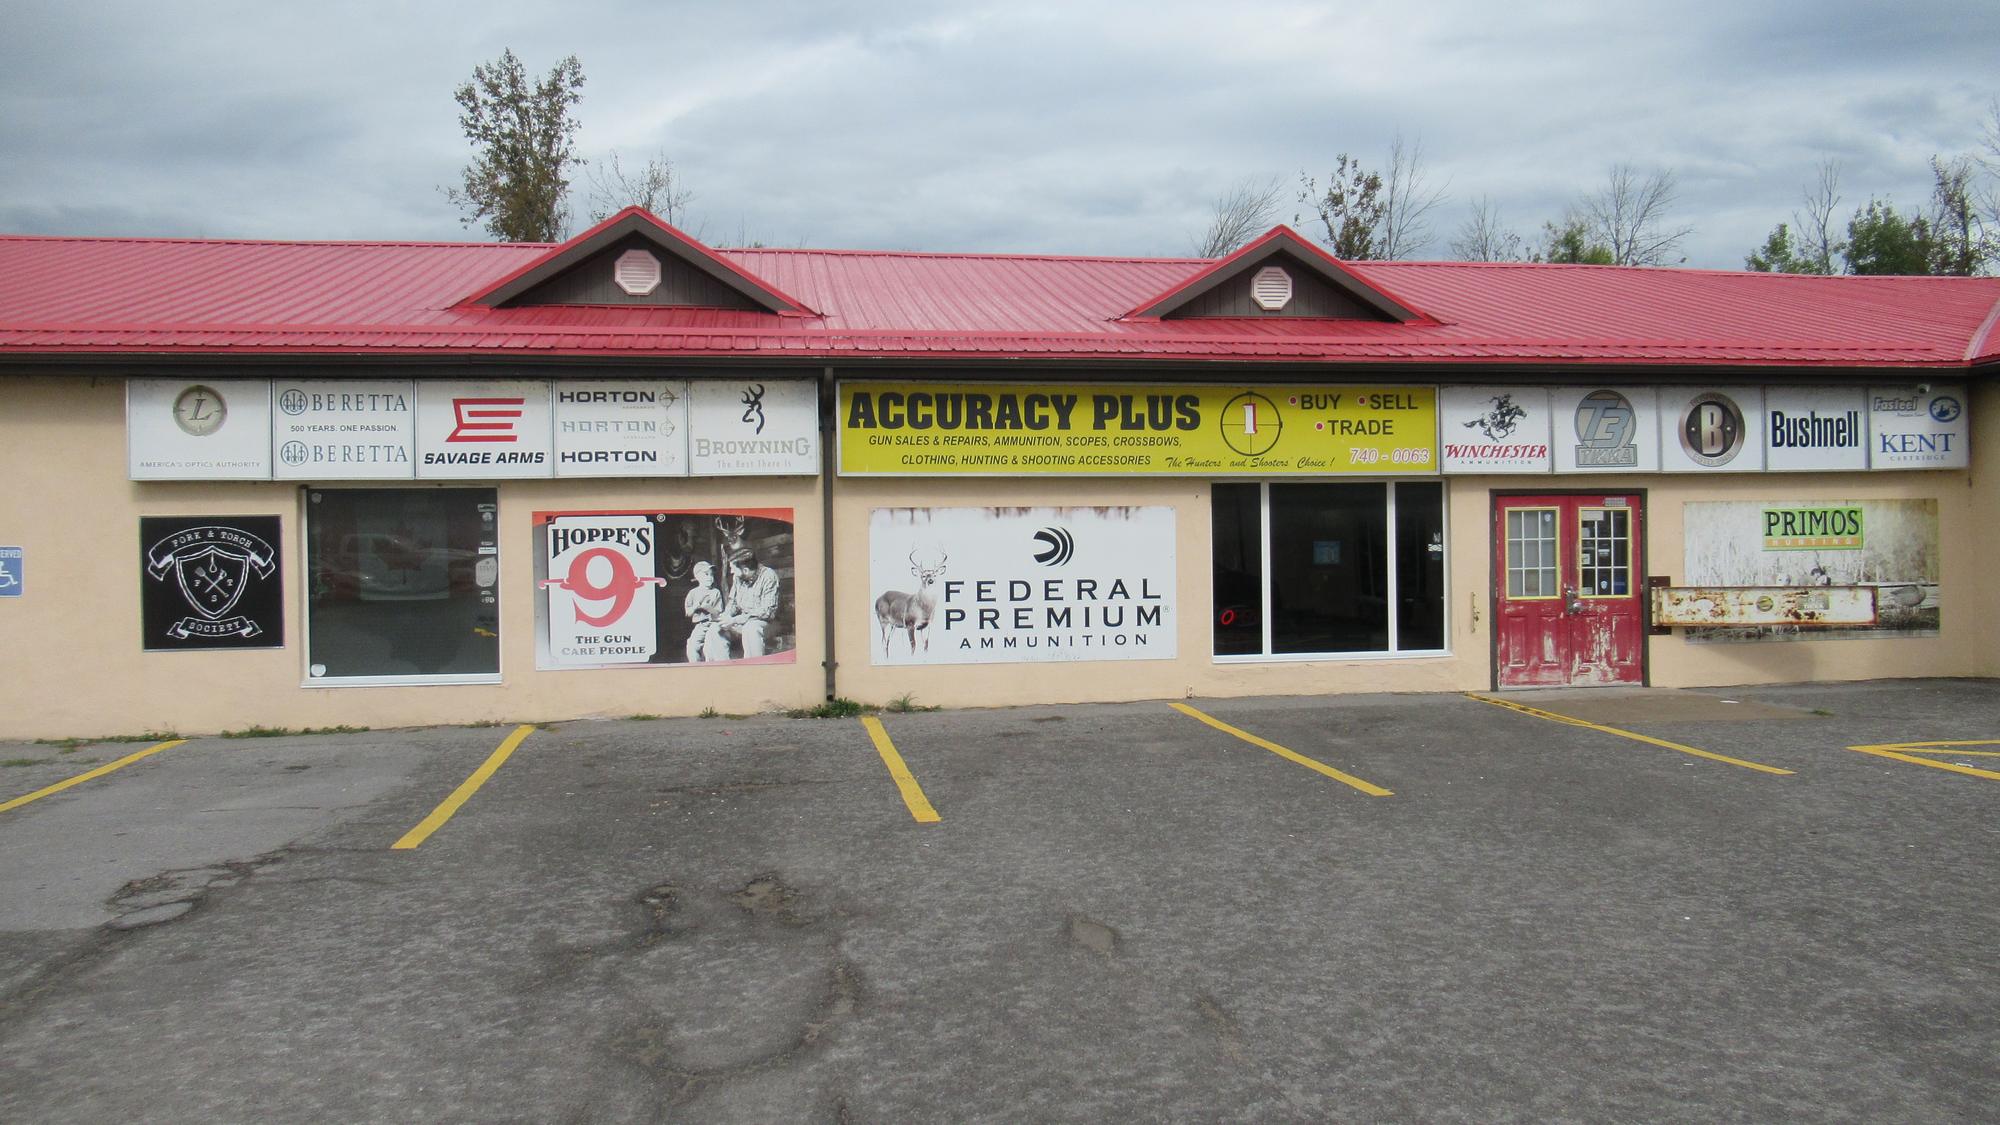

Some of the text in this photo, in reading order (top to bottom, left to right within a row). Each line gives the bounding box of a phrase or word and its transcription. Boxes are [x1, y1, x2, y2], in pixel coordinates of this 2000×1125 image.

[311, 394, 408, 411] BERETTA
[560, 391, 655, 403] HORTON
[1301, 394, 1418, 410] BUY SELL
[848, 391, 1201, 431] ACCURACY PLUS
[561, 421, 656, 432] HORTON
[1328, 420, 1394, 435] TRADE
[1771, 411, 1858, 447] Bushnell
[696, 438, 810, 457] BROWNING
[869, 435, 1182, 447] GUN SALES & REPAIRS, AMMUNITION, SCOPES, CROSSBOWS,
[1880, 433, 1955, 453] KENT
[313, 445, 408, 462] BERETTA
[424, 451, 545, 464] SAVAGE ARMS
[561, 451, 656, 462] HORTON
[1445, 444, 1548, 458] WINCHESTER
[901, 454, 1151, 466] CLOTHING, HUNTING & SHOOTING ACCESSORIES
[1165, 457, 1182, 468] The
[1230, 457, 1247, 468] and
[1764, 510, 1860, 536] PRIMOS
[171, 530, 253, 548] FORK & TORCH
[551, 527, 651, 559] HOPPE'S
[560, 547, 645, 627] 9
[944, 578, 1161, 603] FEDERAL
[944, 605, 1161, 630] PREMIUM
[189, 621, 240, 632] SOCIETY
[575, 634, 632, 645] THE GUN
[959, 634, 1147, 649] AMMUNITION
[561, 646, 646, 656] CARE PEOPLE
